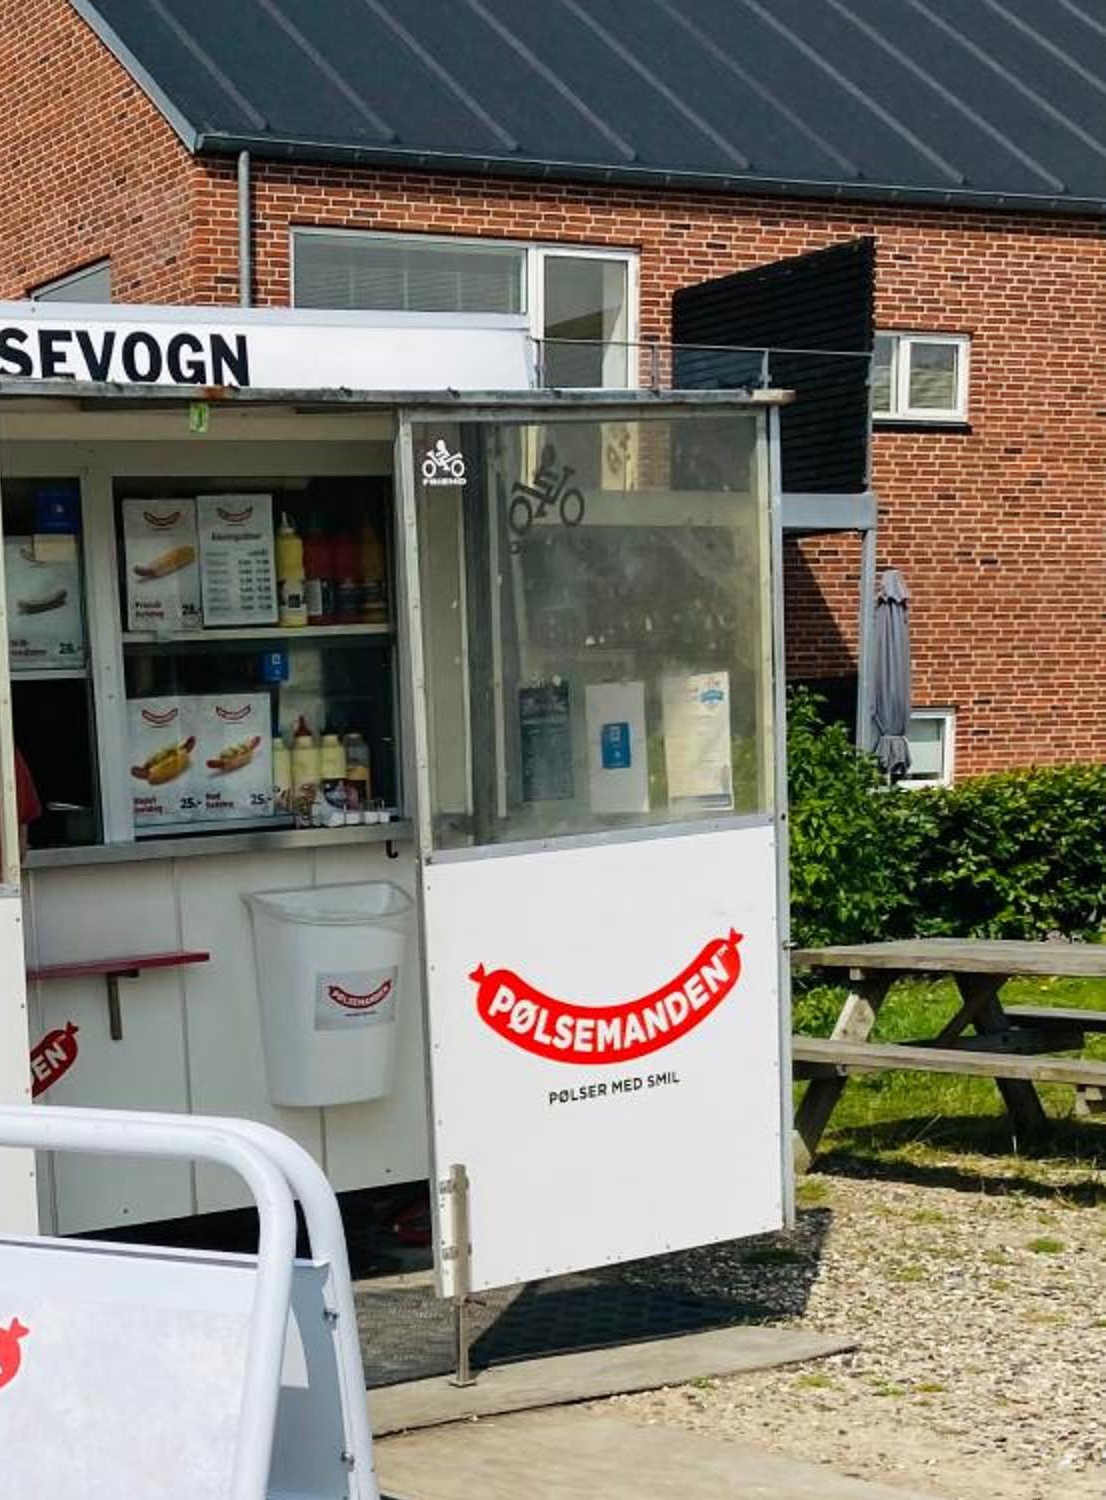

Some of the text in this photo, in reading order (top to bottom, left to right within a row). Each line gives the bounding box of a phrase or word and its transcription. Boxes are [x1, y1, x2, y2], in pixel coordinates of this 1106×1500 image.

[549, 1071, 680, 1105] PØLSER MED SMIL
